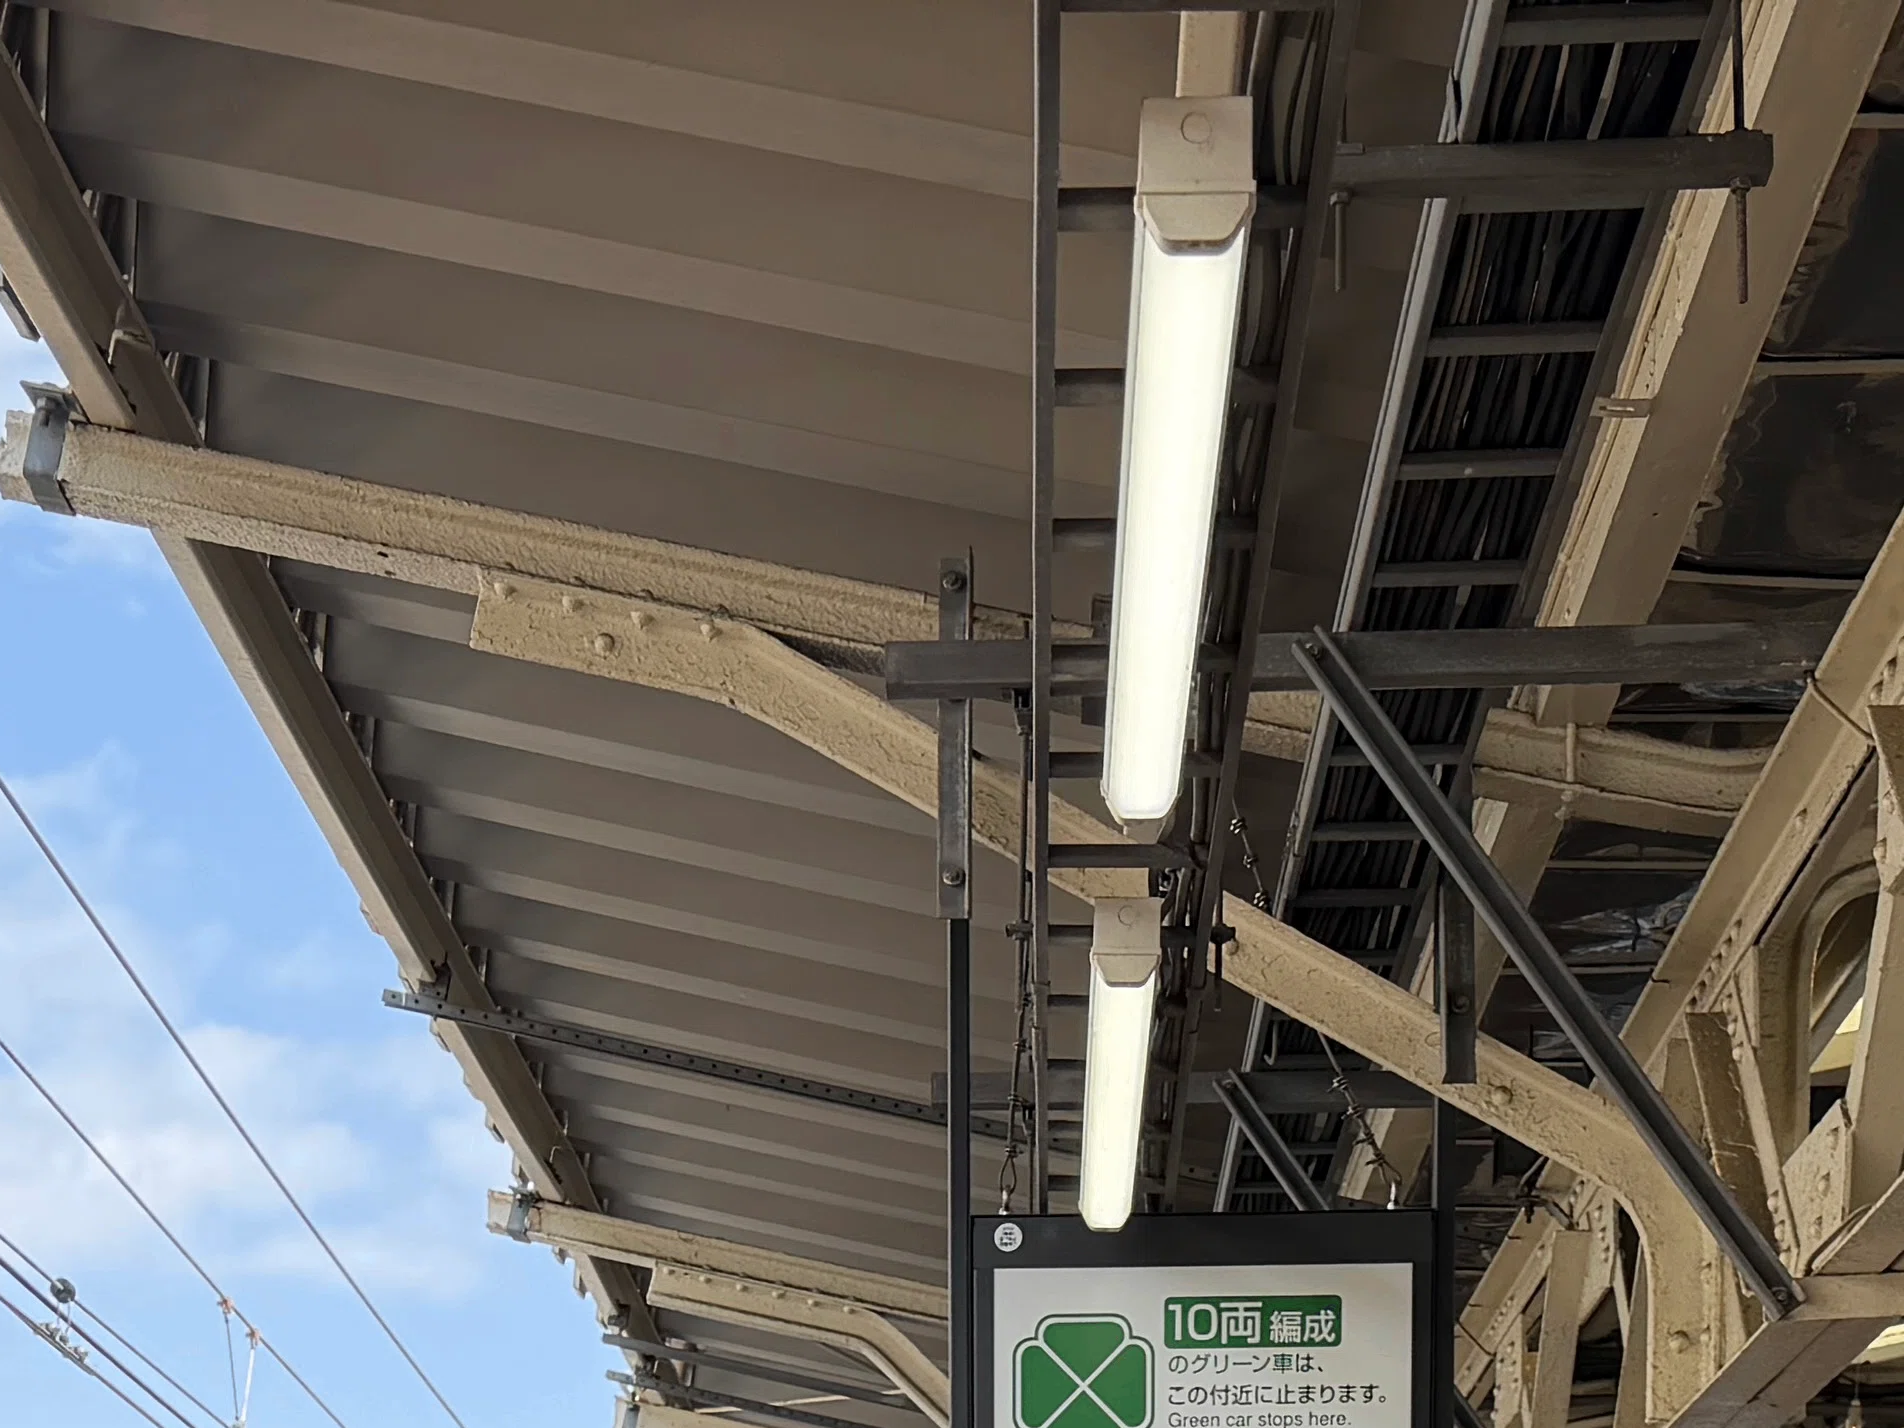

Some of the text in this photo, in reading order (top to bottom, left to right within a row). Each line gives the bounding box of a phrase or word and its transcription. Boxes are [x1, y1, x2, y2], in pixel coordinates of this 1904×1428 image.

[1168, 1353, 1324, 1375] のグリーン車は、
[1168, 1384, 1387, 1406] この付近に止まります。
[1168, 1412, 1220, 1428] Green
[1225, 1415, 1253, 1428] car
[1308, 1411, 1352, 1427] here.
